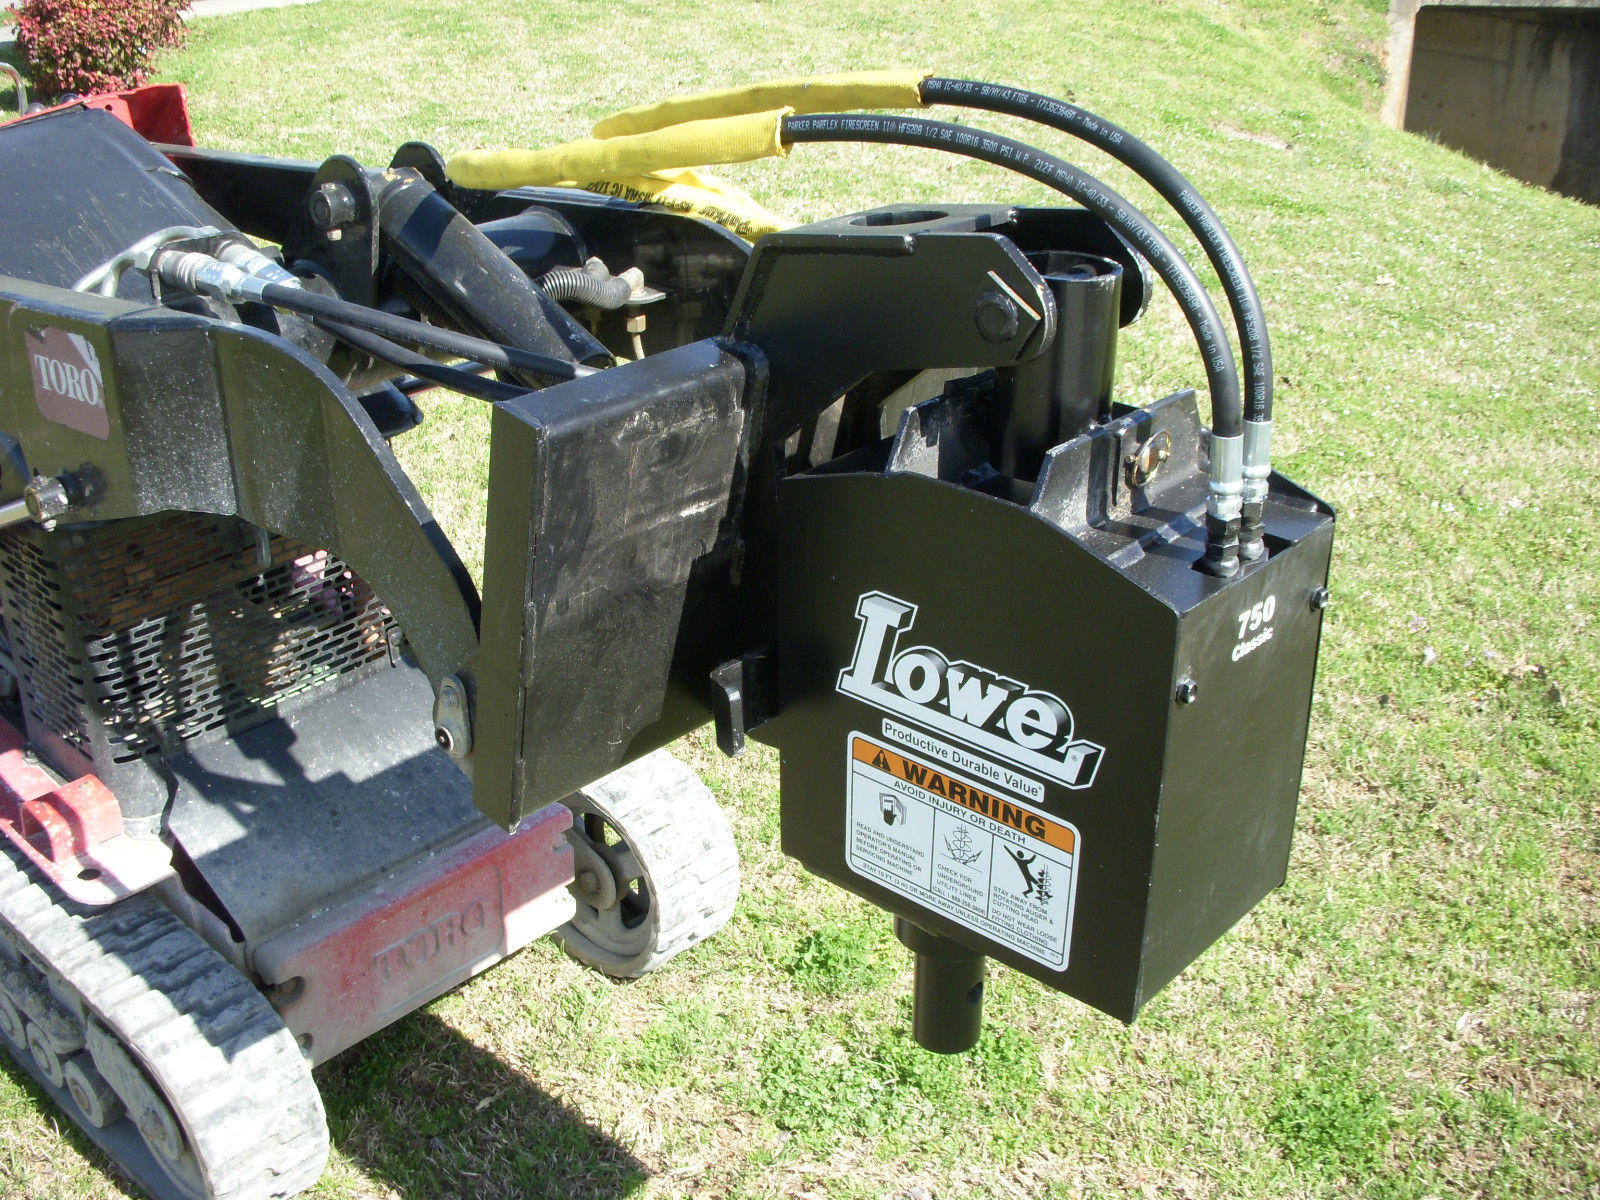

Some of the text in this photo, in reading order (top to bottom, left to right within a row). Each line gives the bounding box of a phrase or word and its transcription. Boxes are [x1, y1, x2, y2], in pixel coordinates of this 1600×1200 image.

[1082, 116, 1099, 131] Made
[1099, 127, 1108, 137] in
[1108, 131, 1123, 145] USA
[1178, 189, 1202, 216] PARKER
[787, 120, 810, 131] PARKER
[812, 119, 839, 131] PARFLEX
[840, 119, 879, 131] FIRESCREEN
[925, 126, 938, 138] 1/2
[940, 129, 953, 142] SAE
[981, 138, 998, 153] 3500
[1000, 145, 1013, 158] PSI
[1034, 158, 1054, 174] 212F
[1075, 180, 1109, 207] IC-40/33
[1144, 236, 1163, 258] FTGS
[1200, 319, 1213, 341] Made
[1207, 343, 1217, 354] in
[1212, 355, 1225, 373] USA
[1216, 246, 1246, 292] FIRESCREEN
[1250, 344, 1263, 359] 1/2
[33, 353, 99, 405] TORO
[1253, 362, 1265, 378] SAE
[1254, 382, 1265, 410] 100R16
[1238, 595, 1276, 640] 750
[884, 722, 949, 759] Productive
[952, 750, 1000, 780] Durable
[893, 780, 1026, 844] AVOID INJURY OR DEATH
[902, 759, 1046, 839] WARNING
[856, 821, 925, 858] READ AND UNDERSTAND
[856, 836, 922, 872] BEFORE OPERATING OR
[892, 846, 917, 862] MANUAL
[855, 844, 913, 876] SERVICING MACHINE
[937, 863, 972, 884] CHECK FOR
[936, 879, 977, 903] UTILITY LINES
[937, 871, 984, 897] UNDERGROUND
[993, 885, 1048, 915] STAY AWAY FROM
[863, 862, 877, 874] STAY
[909, 884, 918, 893] OR
[919, 889, 936, 902] MORE
[937, 900, 954, 911] AWAY
[955, 907, 979, 924] UNLESS
[980, 919, 1015, 941] OPERATING
[1016, 936, 1046, 956] MACHINE
[992, 892, 1024, 911] ROTATING
[1025, 907, 1048, 922] AUGER
[992, 900, 1039, 925] CUTTING HEAD
[991, 907, 1058, 943] DO NOT WEAR LOOSE
[991, 914, 1048, 946] FITTING CLOTHING
[372, 900, 484, 985] TORO
